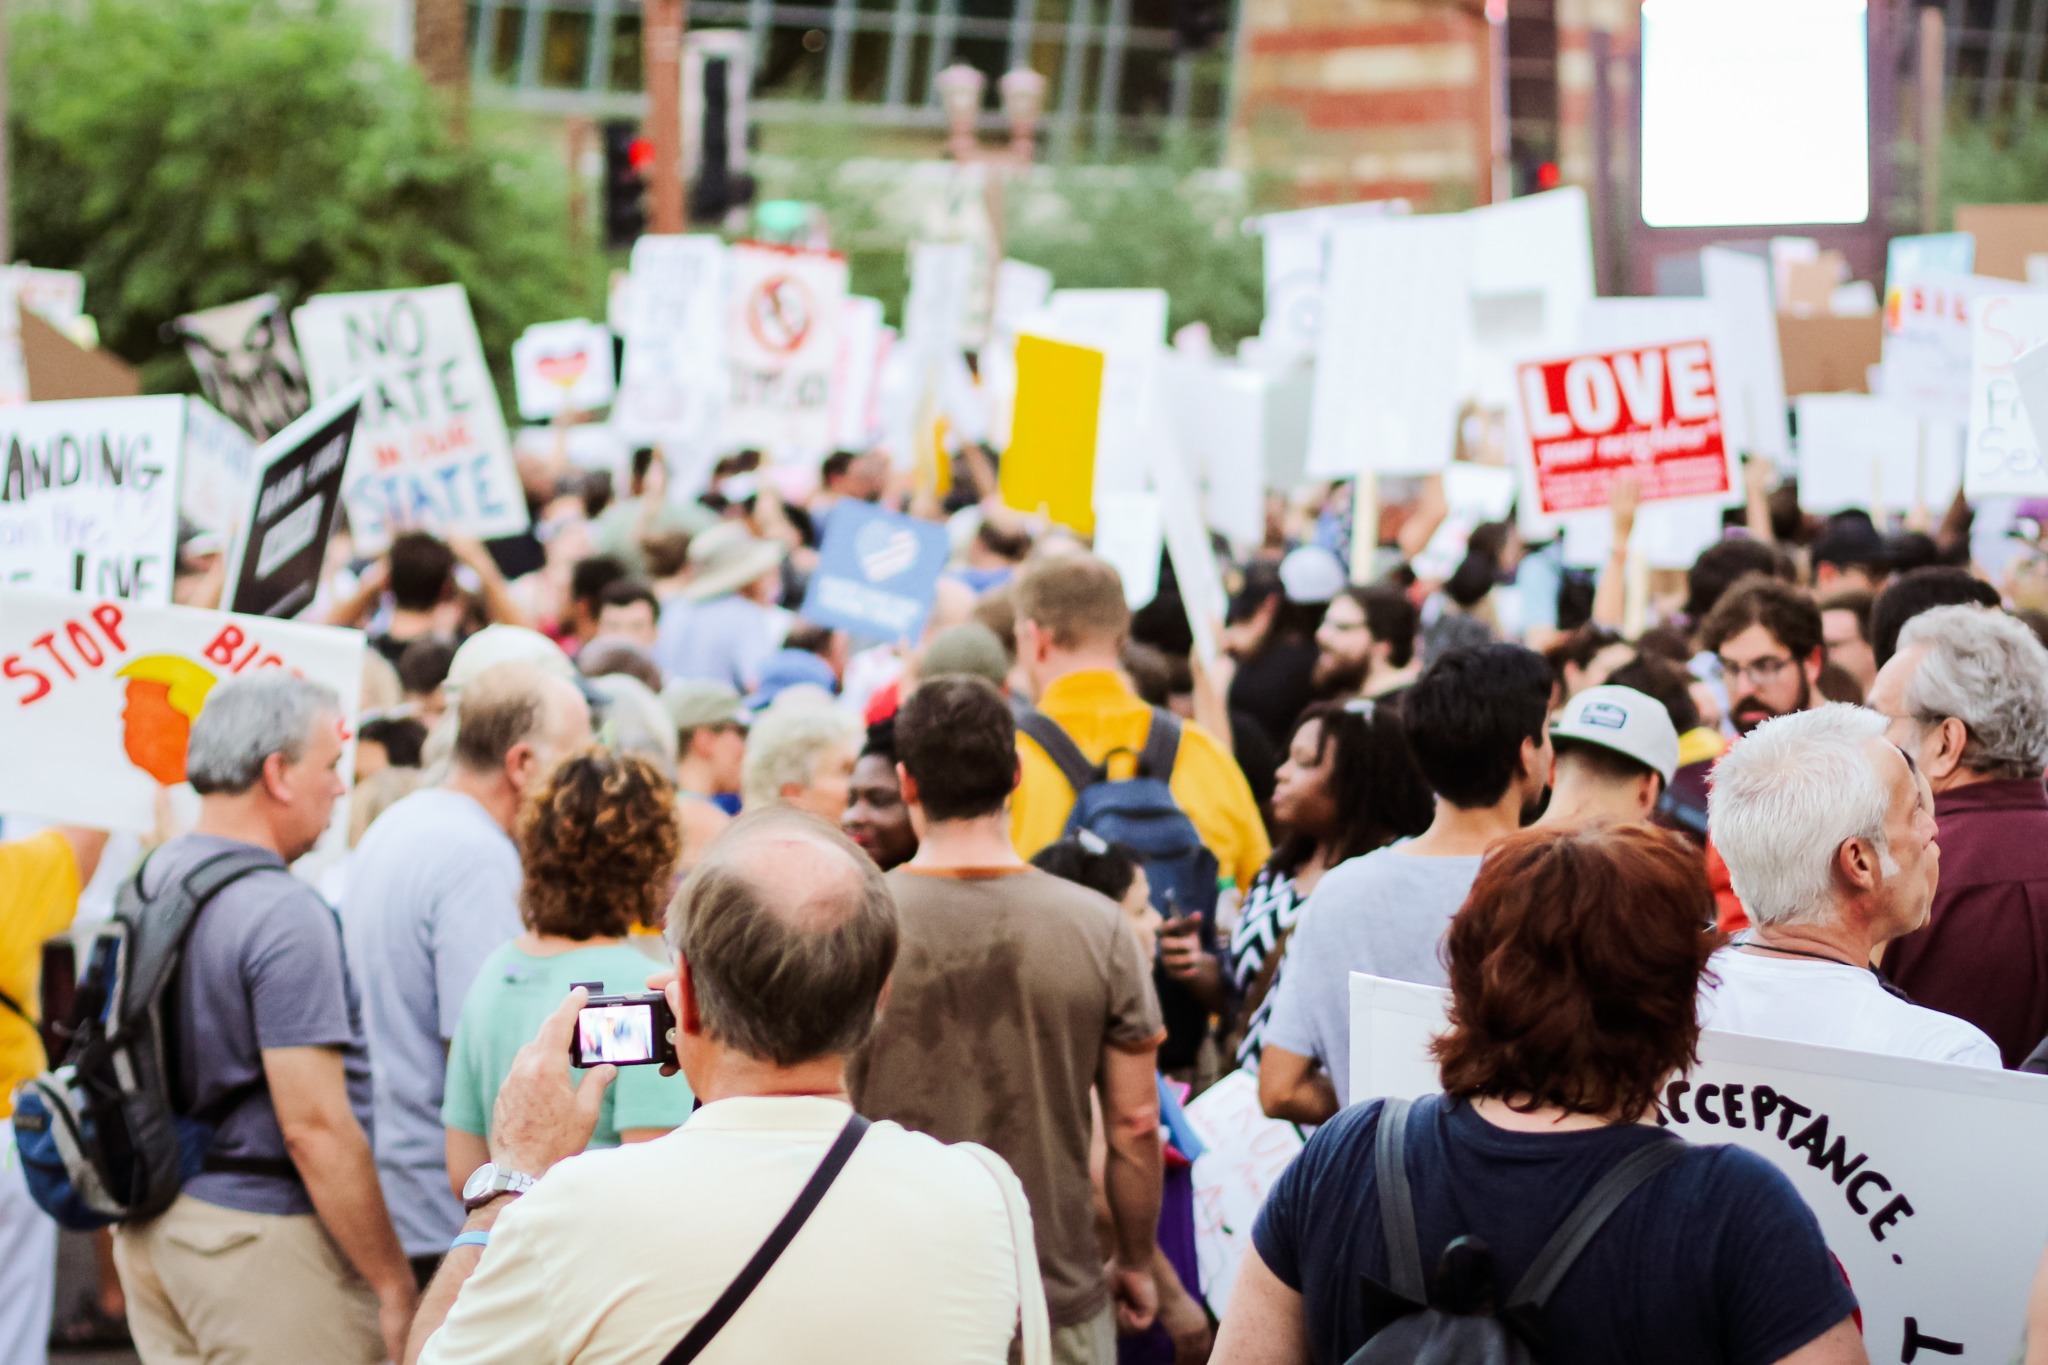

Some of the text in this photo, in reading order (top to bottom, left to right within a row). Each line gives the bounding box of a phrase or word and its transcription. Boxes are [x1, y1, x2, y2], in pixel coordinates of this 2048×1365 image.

[342, 298, 427, 362] NO
[1523, 346, 1718, 437] LOVE
[0, 430, 164, 502] ANDING
[350, 454, 507, 533] STATE
[2, 603, 128, 706] STOP
